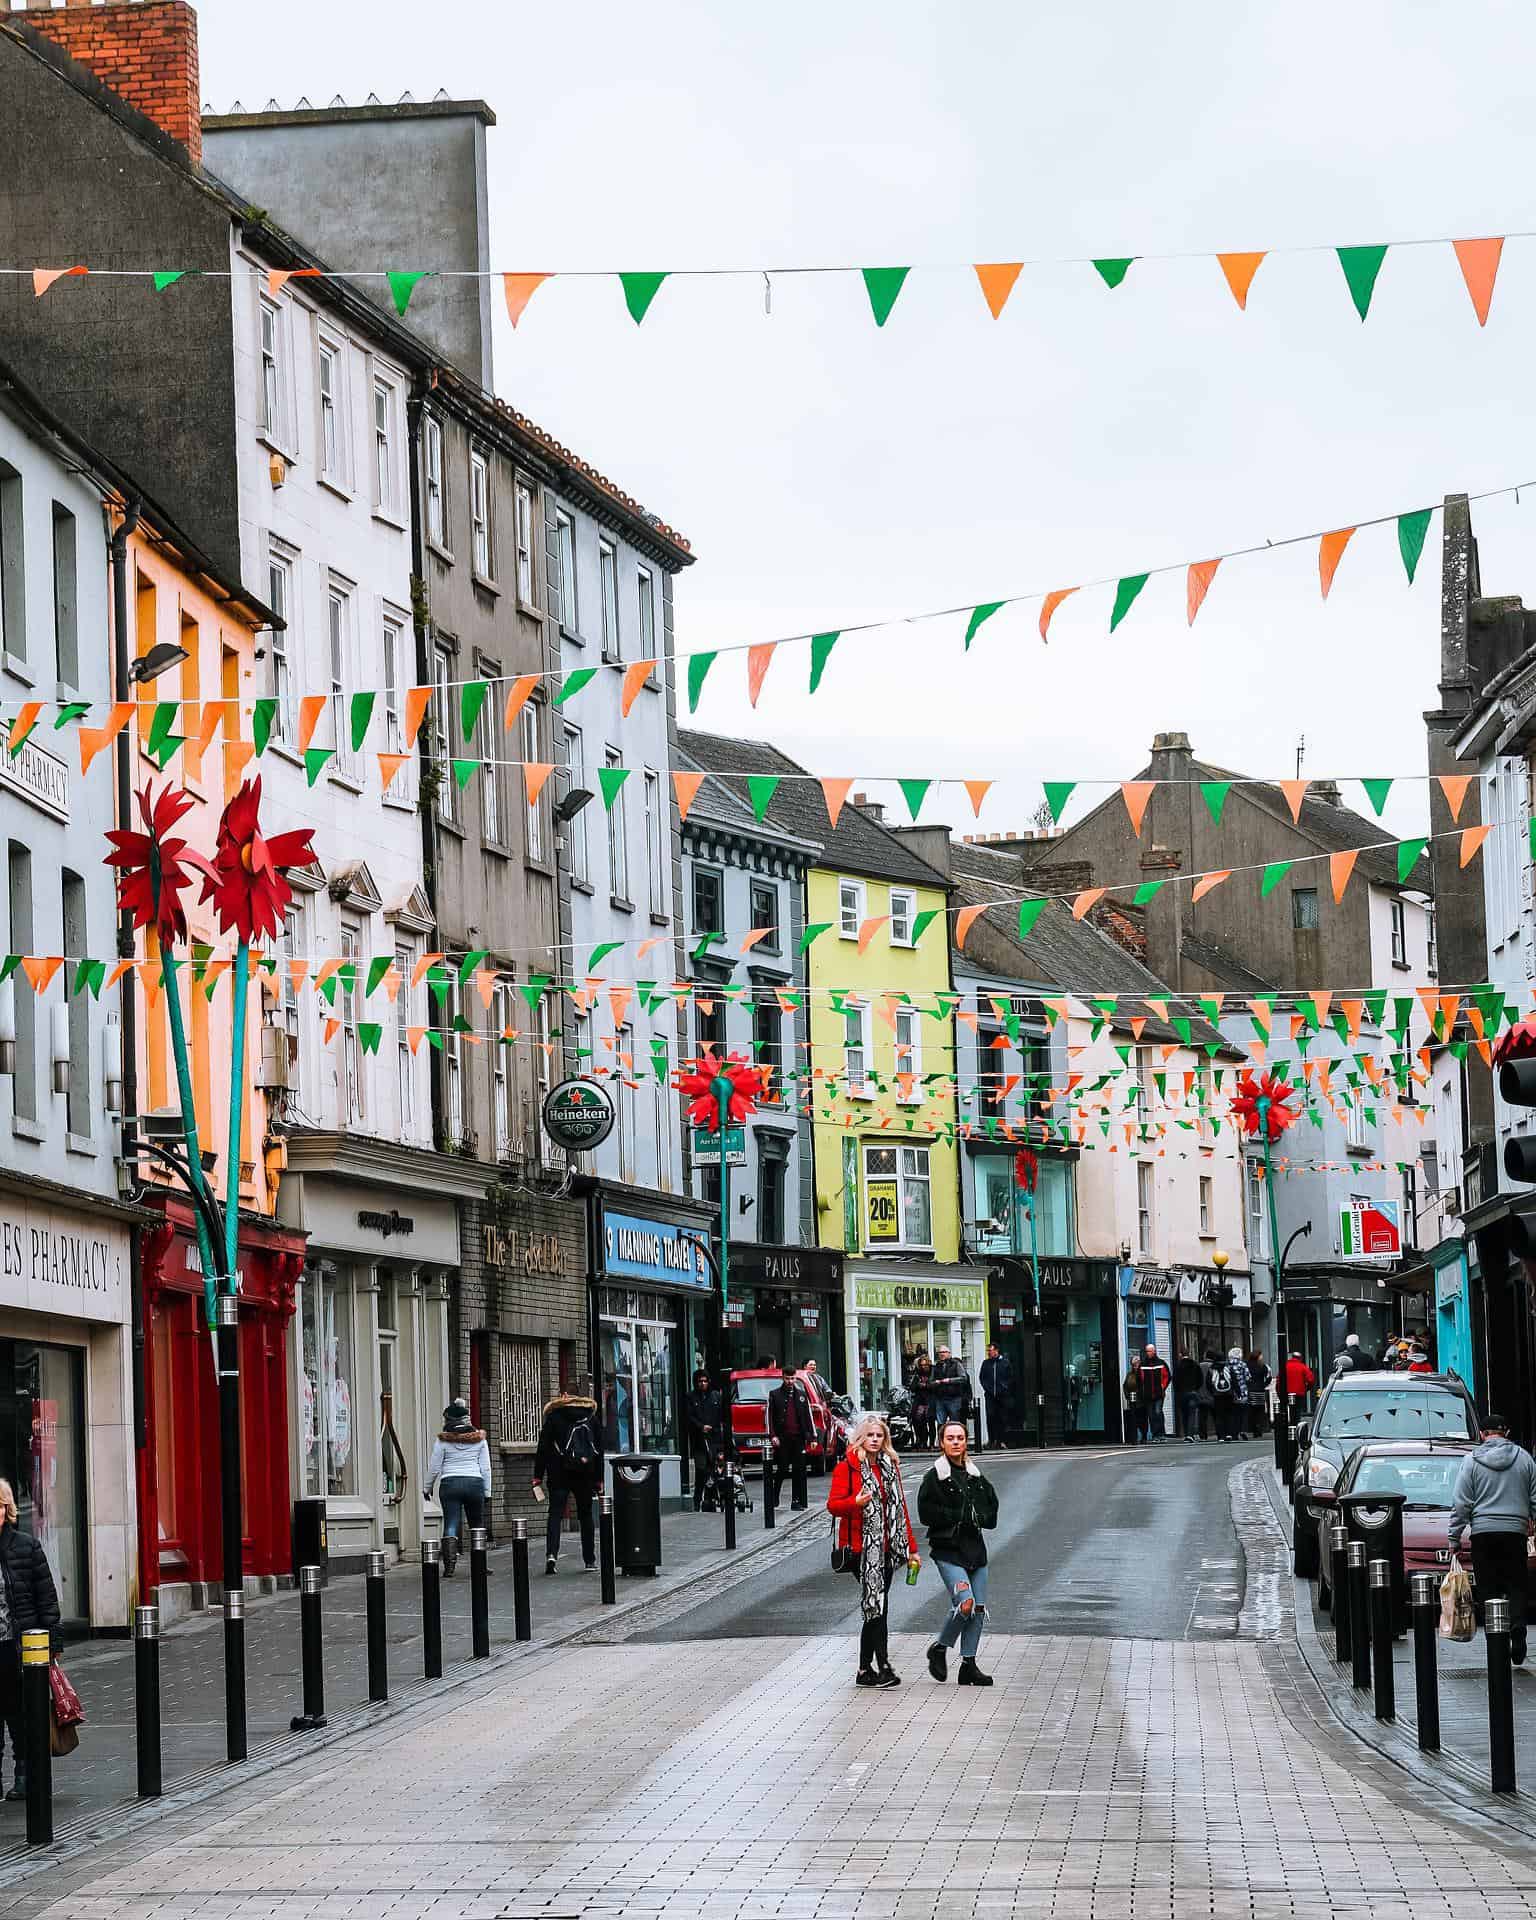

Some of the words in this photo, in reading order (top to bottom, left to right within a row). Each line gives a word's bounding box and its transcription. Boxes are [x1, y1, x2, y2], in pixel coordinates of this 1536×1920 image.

[20, 749, 67, 806] PHARMACY
[549, 1108, 607, 1121] Heineken
[1352, 1202, 1365, 1210] TO
[484, 1225, 506, 1266] The
[606, 1226, 613, 1258] 9
[618, 1227, 660, 1266] MANNING
[662, 1236, 692, 1271] TRAVEL
[1351, 1211, 1361, 1254] FitzGerald
[3, 1222, 22, 1277] ES
[31, 1228, 108, 1292] PHARMACY
[765, 1256, 800, 1278] PAULS
[894, 1286, 948, 1309] GRAHAMS
